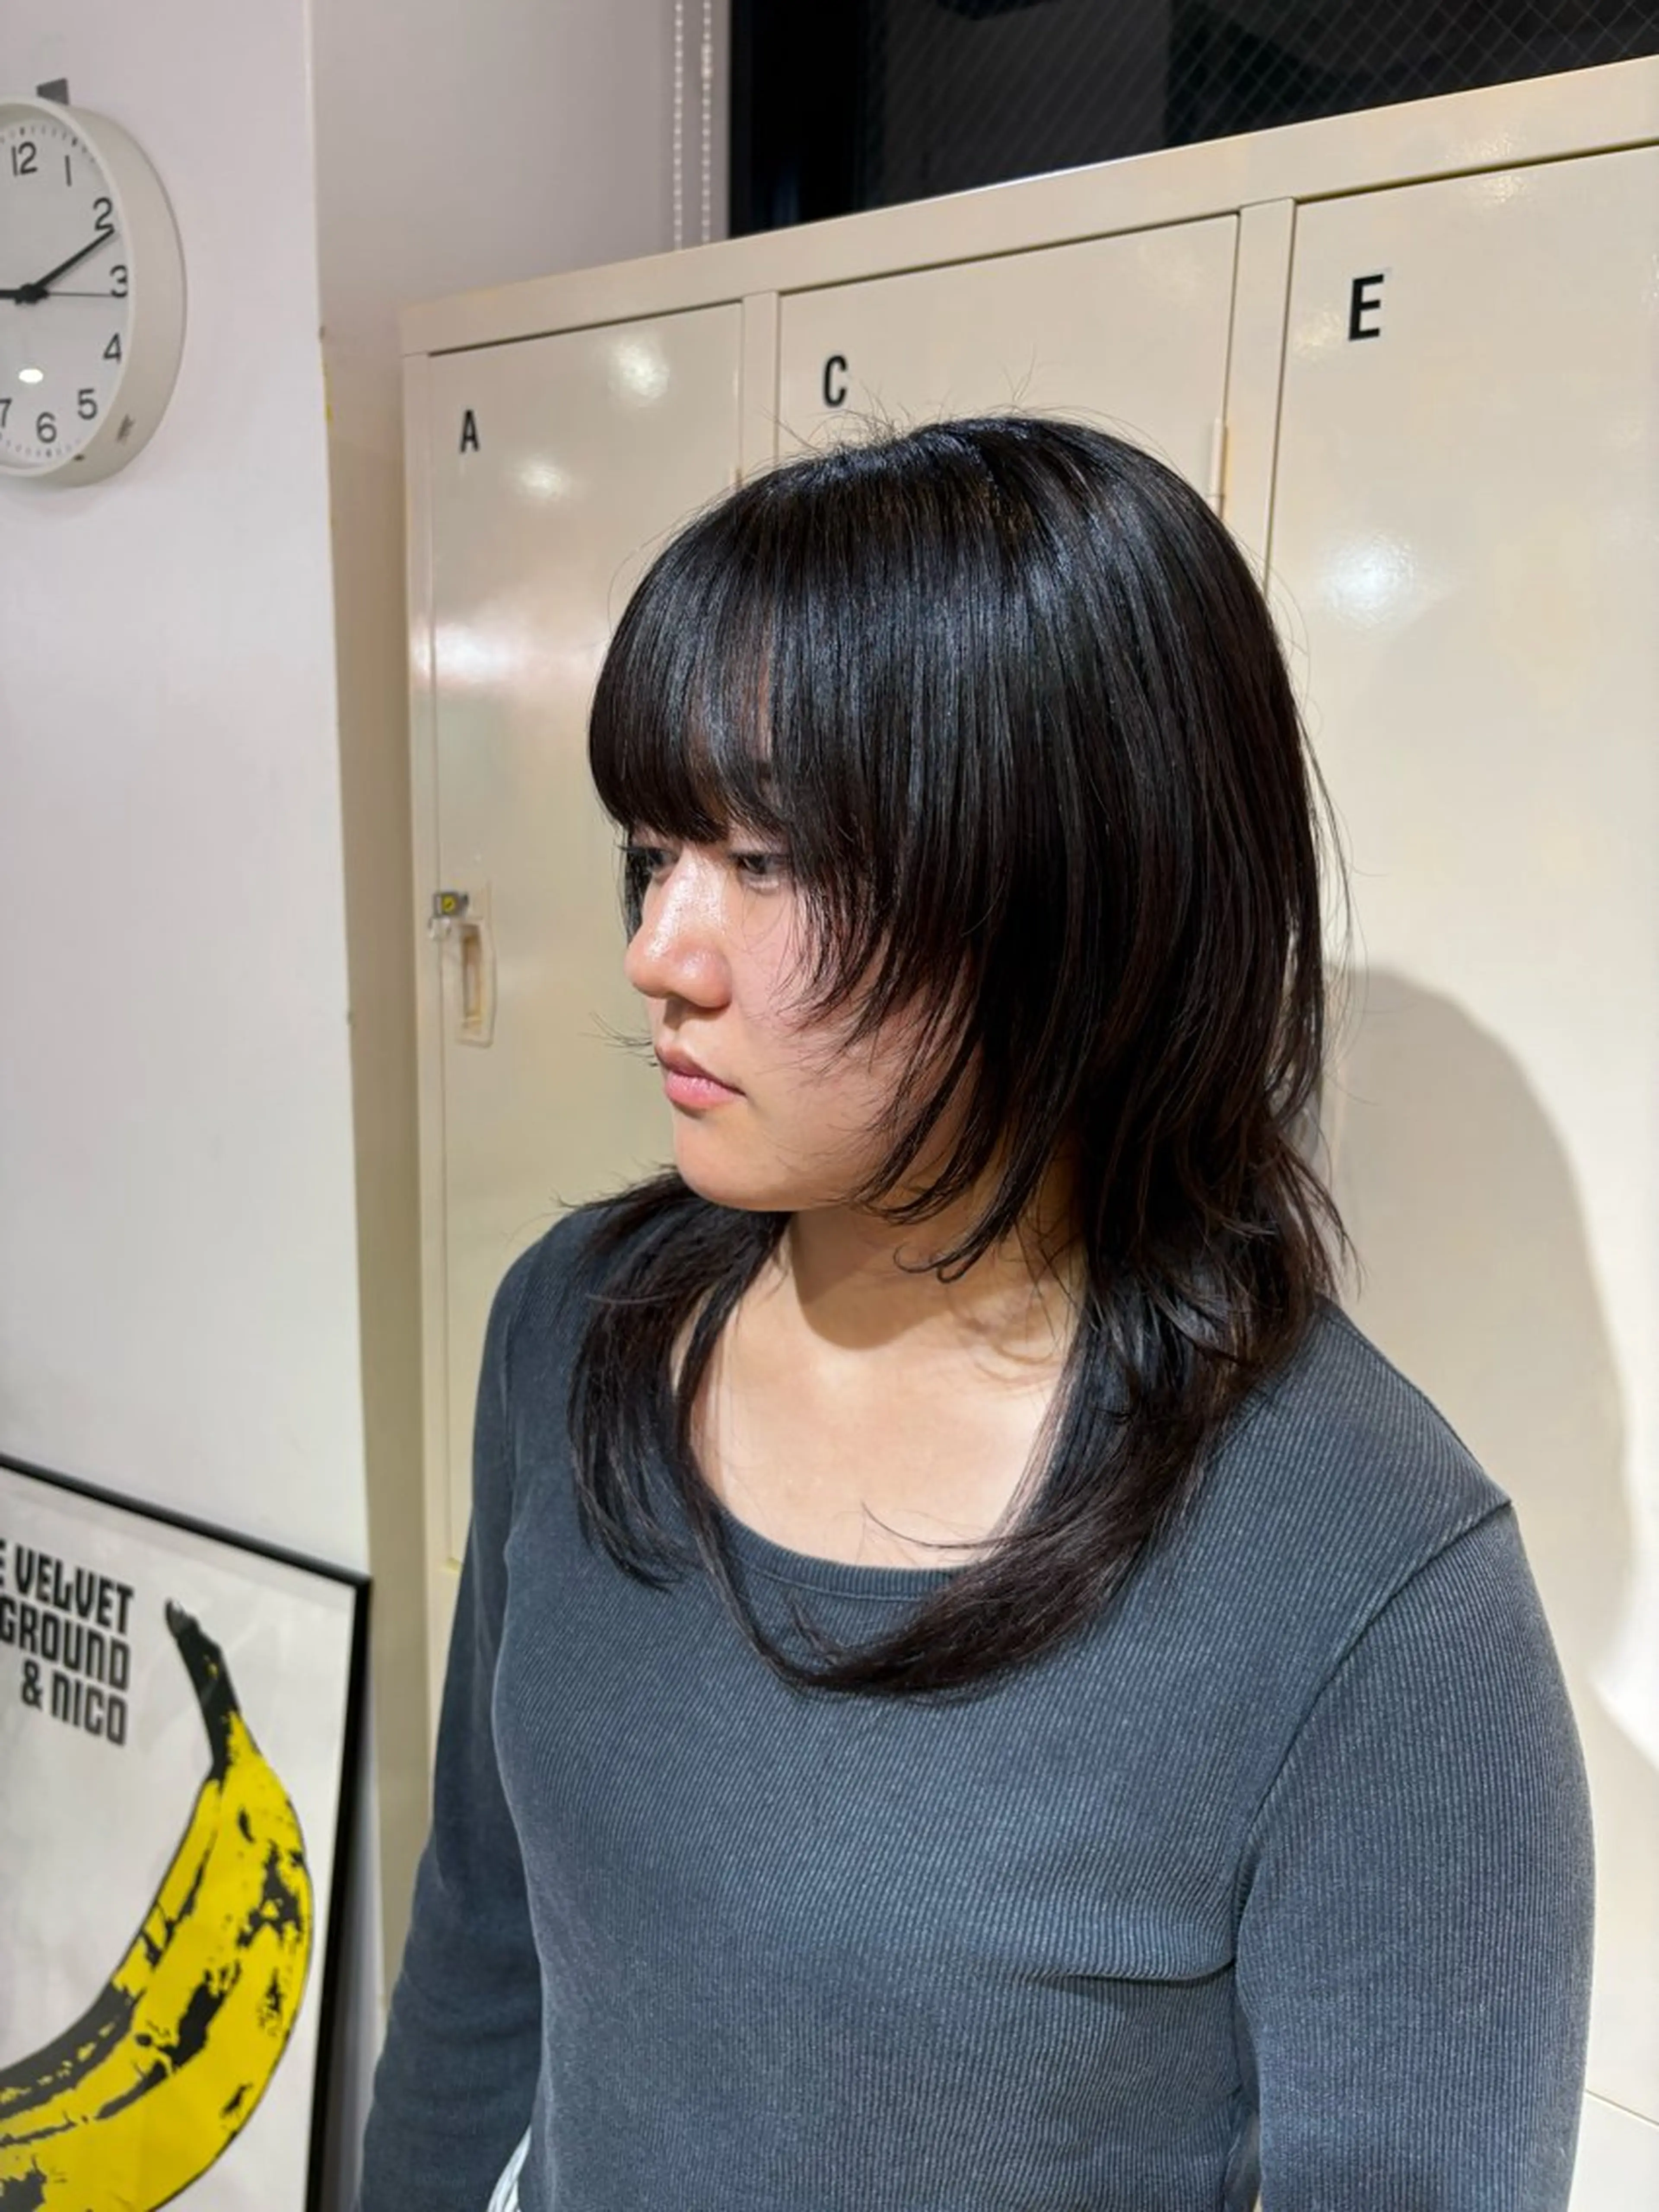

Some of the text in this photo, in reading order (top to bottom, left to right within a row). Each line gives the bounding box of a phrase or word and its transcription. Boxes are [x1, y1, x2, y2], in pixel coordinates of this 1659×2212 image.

[11, 141, 38, 177] 12
[65, 155, 71, 187] 1
[93, 197, 113, 231] 2
[110, 264, 127, 298] 3
[1349, 273, 1384, 341] E
[103, 334, 122, 363] 4
[823, 355, 847, 408] C
[0, 397, 12, 428] 7
[78, 389, 98, 420] 5
[36, 412, 57, 443] 6
[459, 409, 480, 453] A
[15, 1544, 134, 1635] VELVET
[22, 1658, 127, 1746] & NICO
